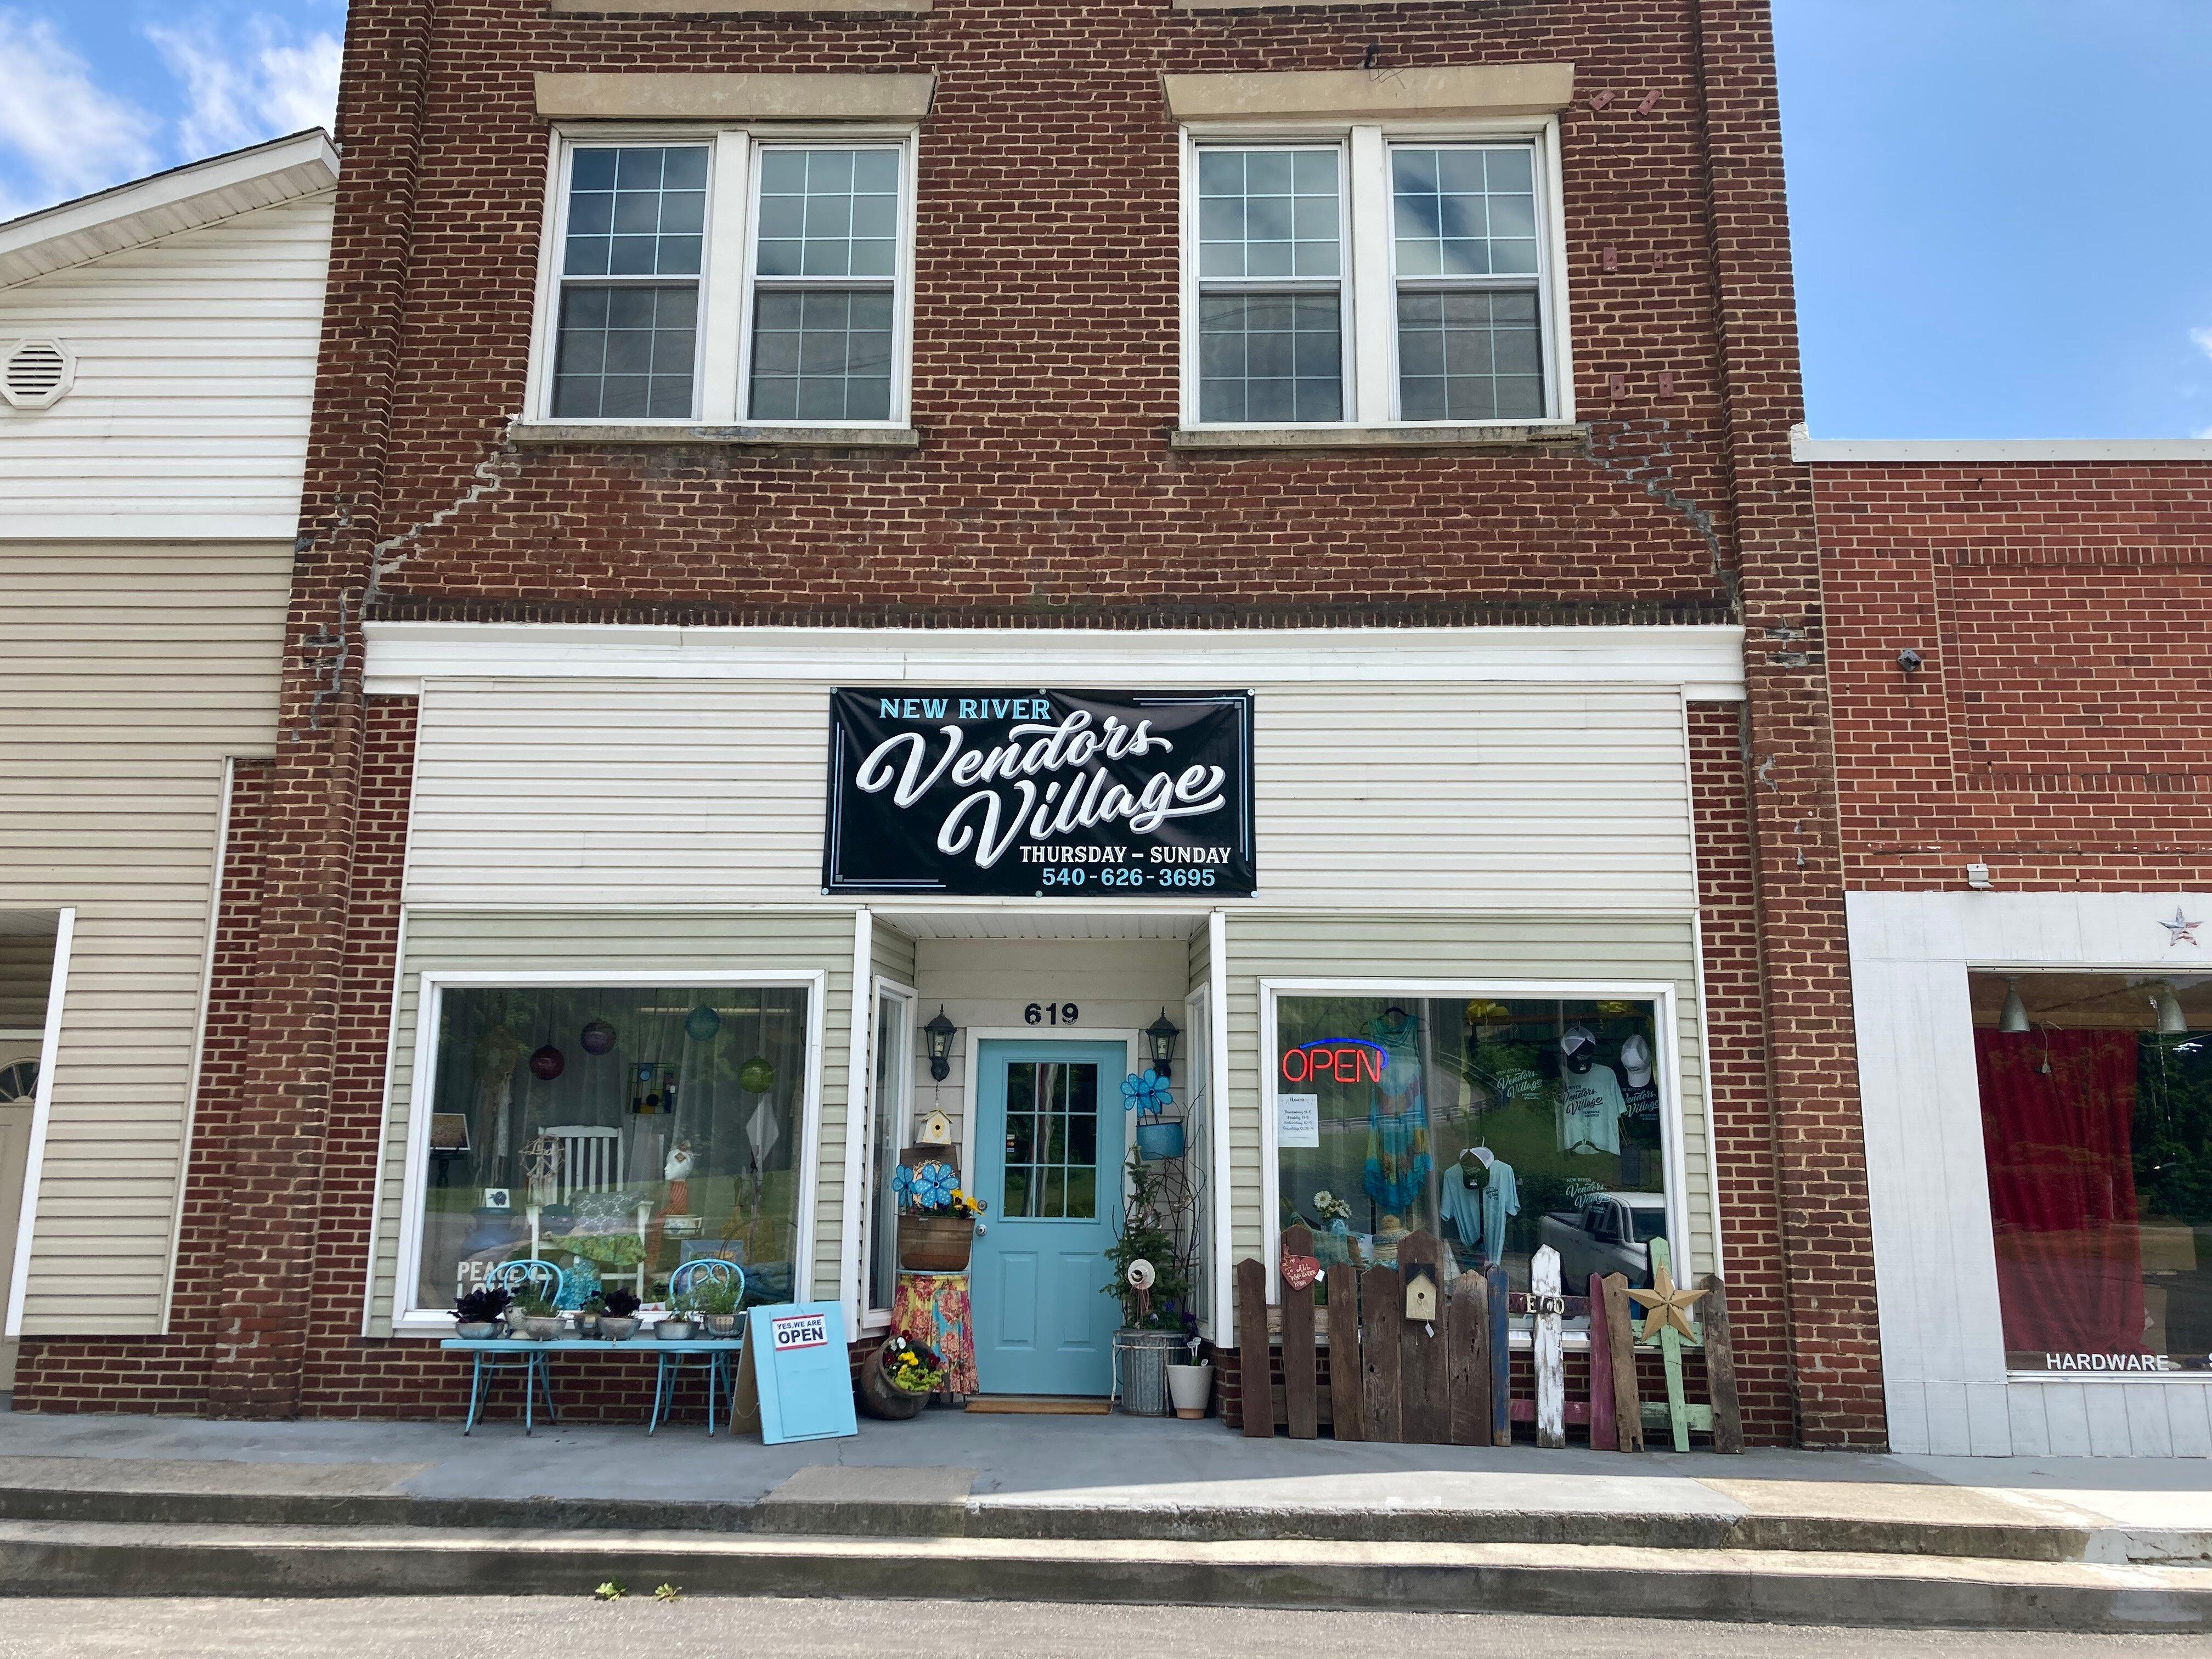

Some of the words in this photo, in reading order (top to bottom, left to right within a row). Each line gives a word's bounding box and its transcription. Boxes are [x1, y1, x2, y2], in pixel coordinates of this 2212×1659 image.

[879, 698, 949, 719] NEW
[958, 699, 1052, 720] RIVER
[855, 710, 1173, 809] Vendors
[937, 764, 1226, 869] Village
[1019, 846, 1127, 863] THURSDAY
[1150, 847, 1232, 864] SUNDAY
[1024, 1003, 1079, 1025] 619
[1283, 1048, 1380, 1082] OPEN
[1497, 1070, 1538, 1091] Vendors
[1506, 1079, 1543, 1099] Village
[1566, 1097, 1604, 1115] Village
[1624, 1099, 1659, 1118] Village
[1565, 1181, 1607, 1198] Vendors
[1574, 1193, 1611, 1209] Village
[1296, 1263, 1311, 1272] ALL
[806, 1319, 822, 1327] ARE
[778, 1327, 823, 1344] OPEN
[2046, 1353, 2171, 1371] HARDWARE
